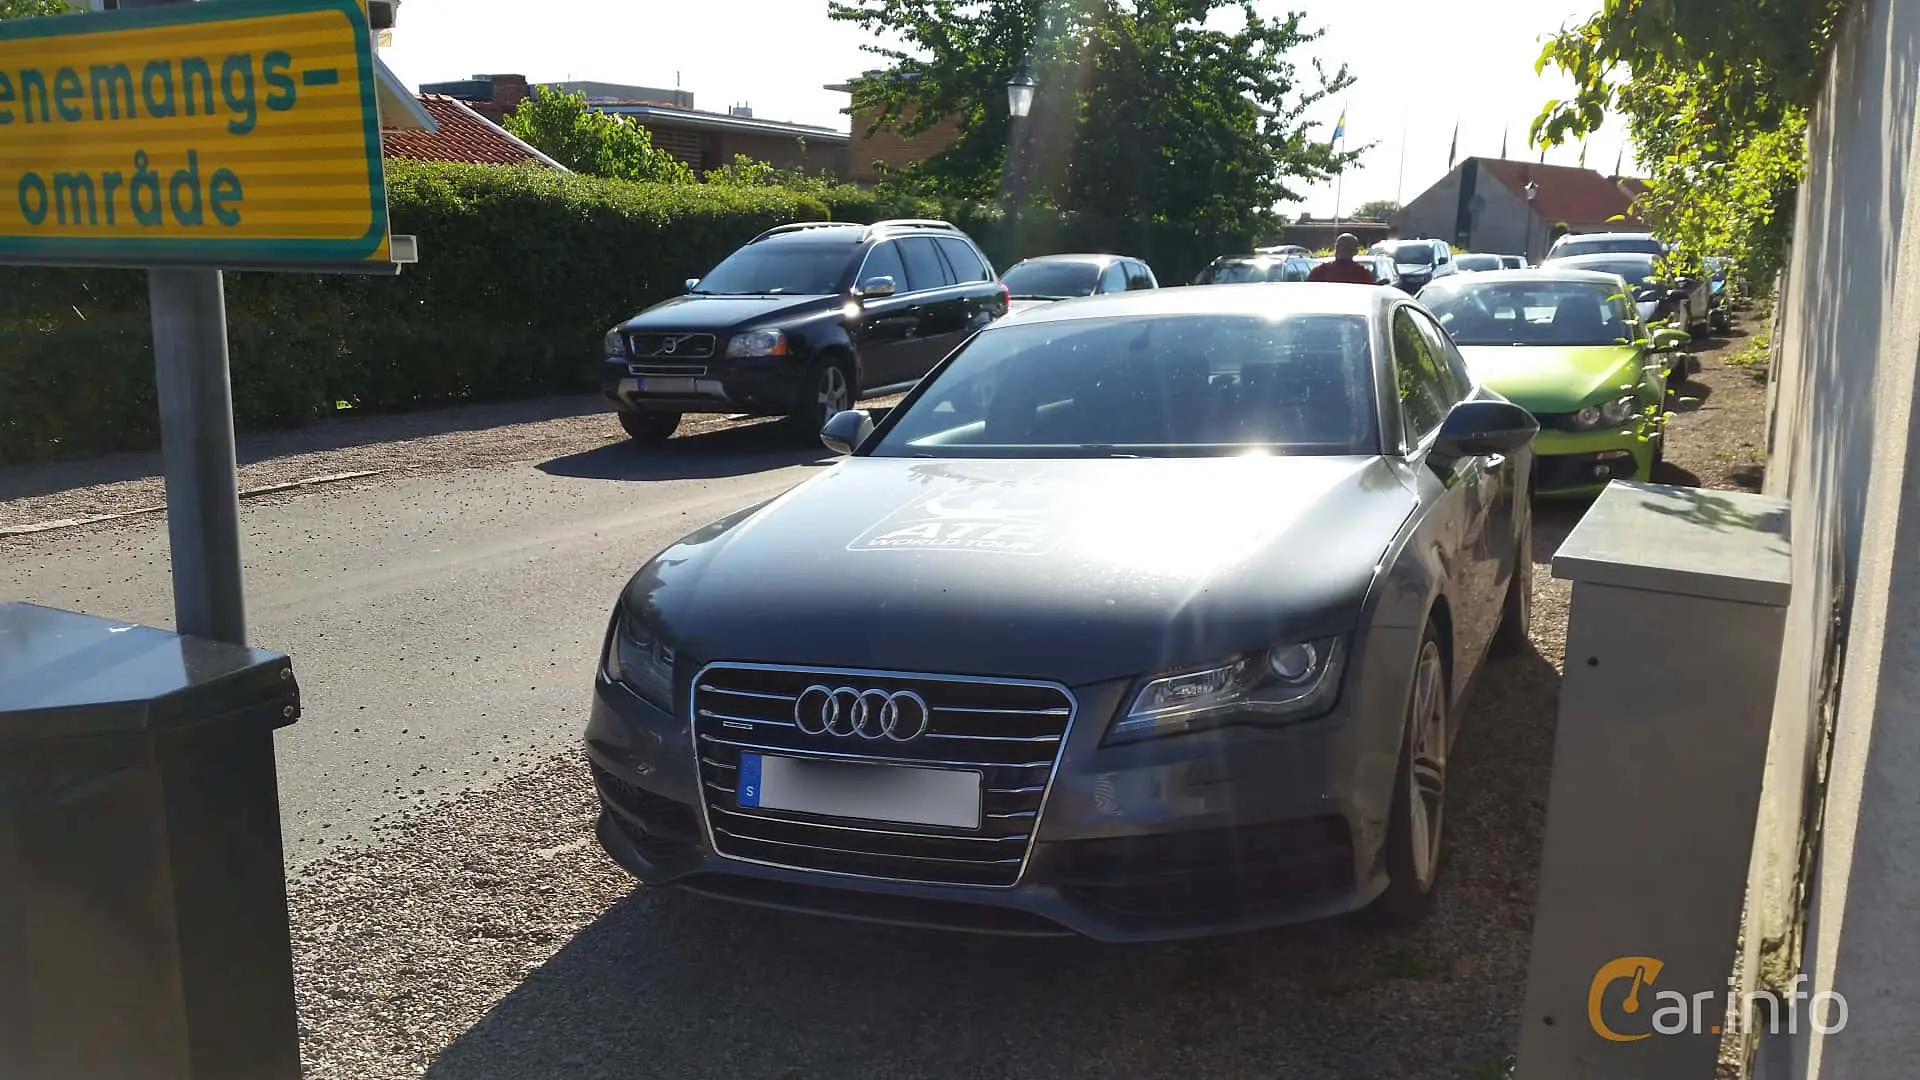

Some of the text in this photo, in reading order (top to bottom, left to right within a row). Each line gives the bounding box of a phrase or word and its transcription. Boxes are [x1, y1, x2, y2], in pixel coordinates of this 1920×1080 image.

[18, 149, 243, 227] område
[867, 537, 959, 547] WORLD
[746, 785, 754, 797] S
